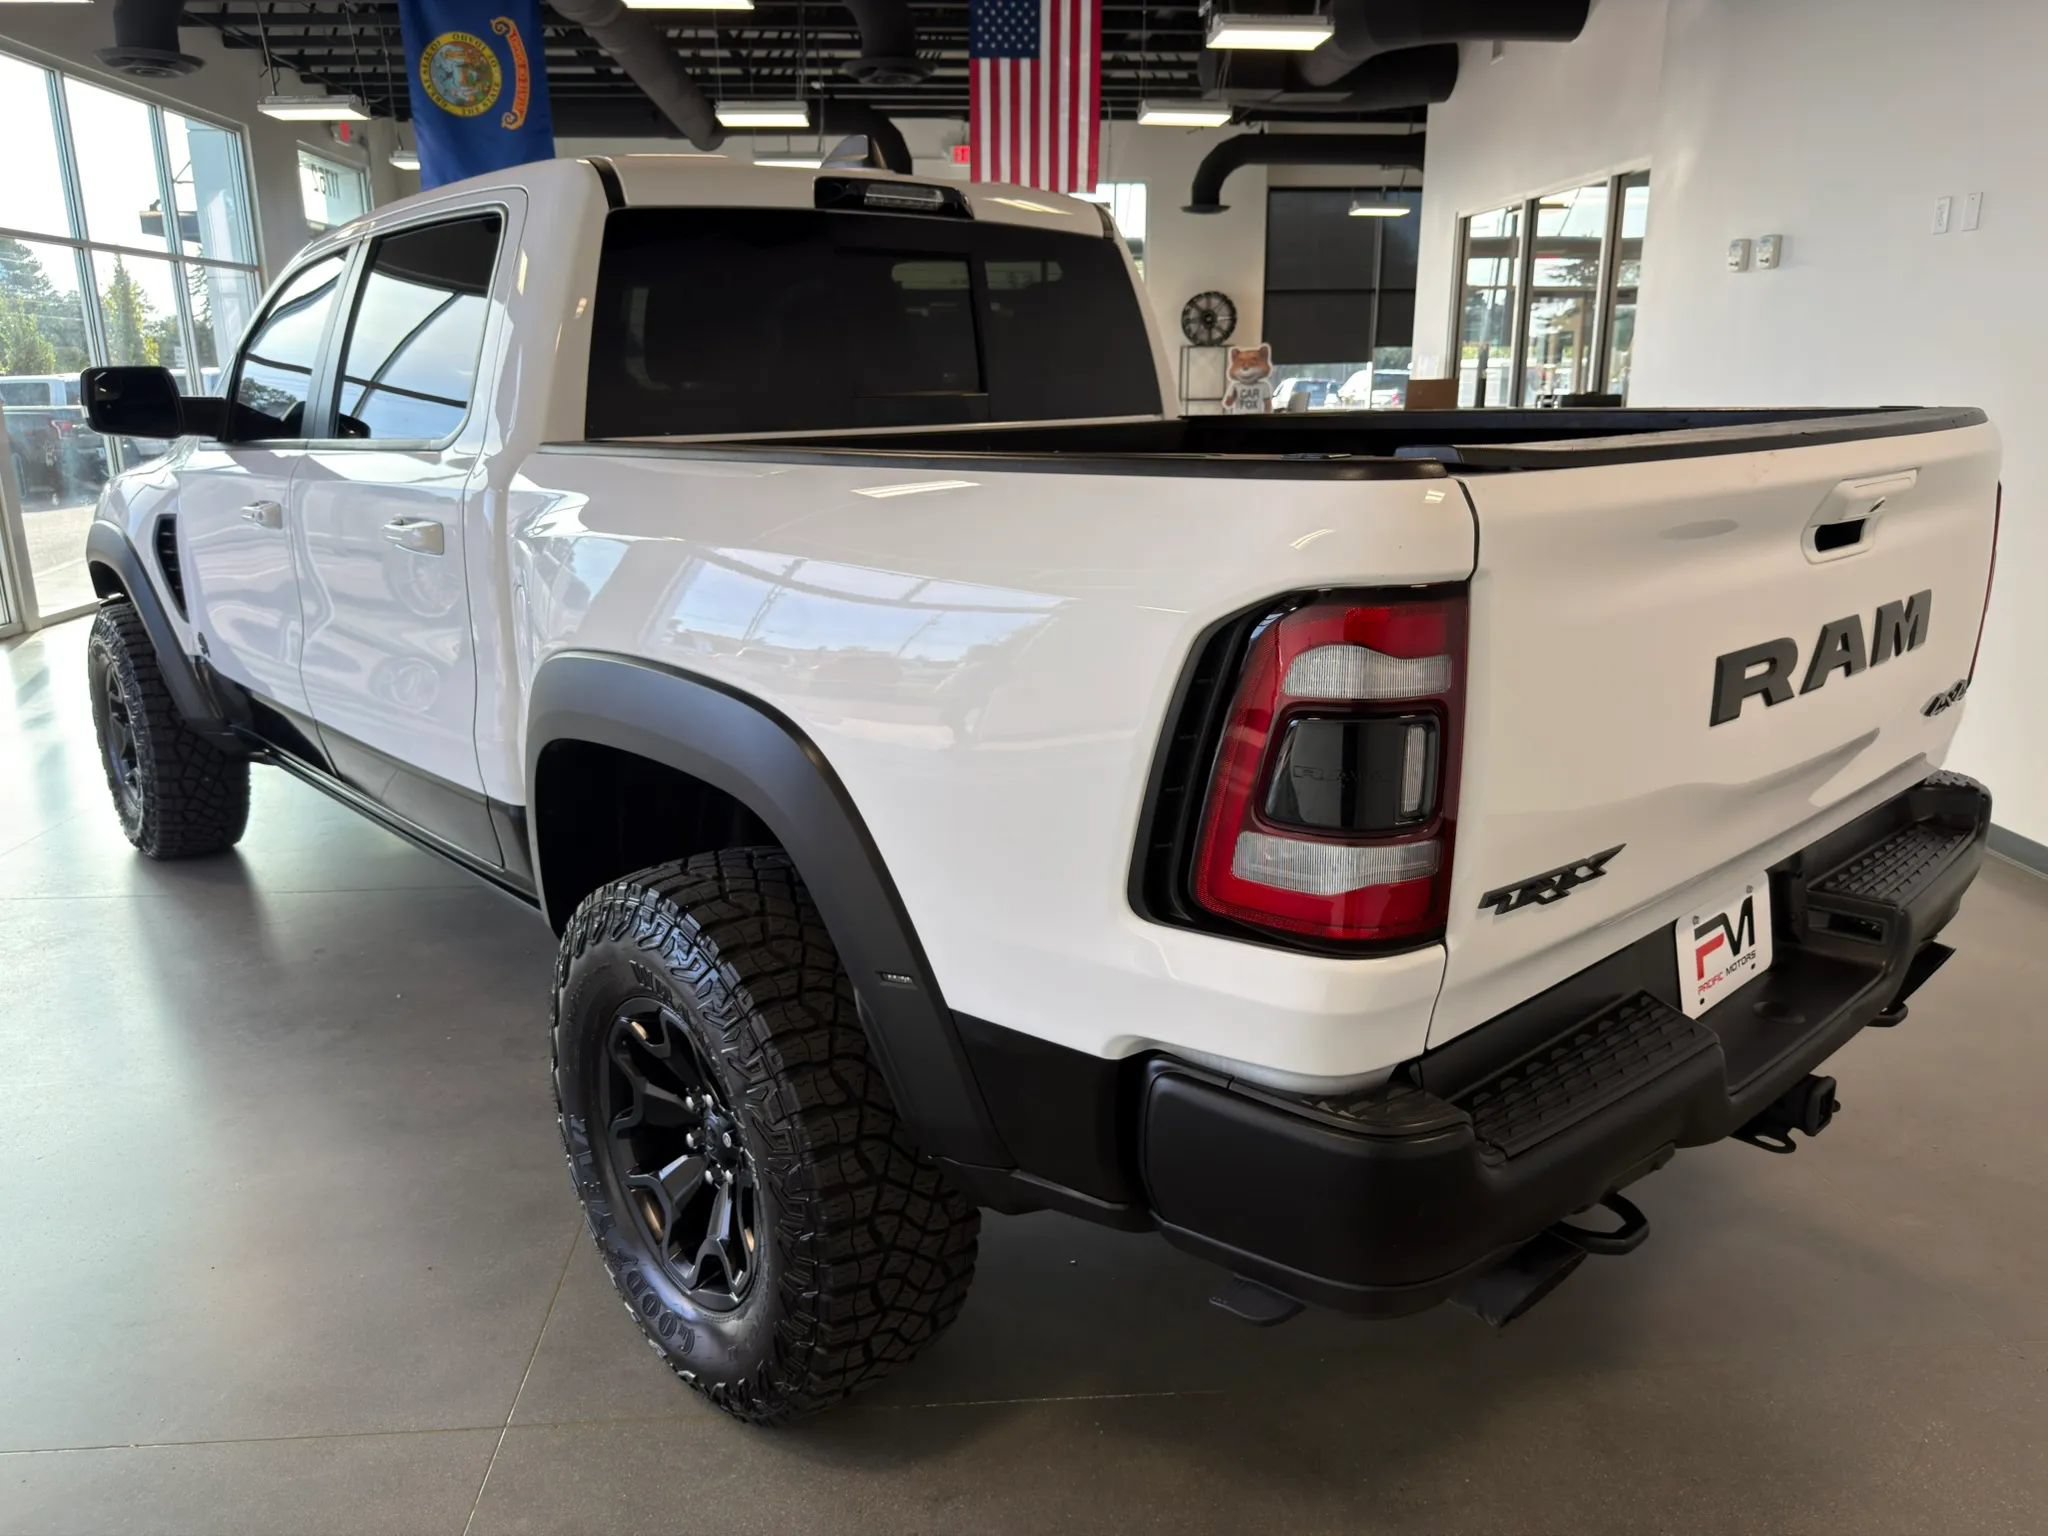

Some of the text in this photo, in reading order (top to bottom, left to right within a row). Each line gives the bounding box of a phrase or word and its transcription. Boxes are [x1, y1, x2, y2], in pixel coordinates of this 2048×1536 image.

[1240, 388, 1260, 400] CAR
[1709, 588, 1932, 727] RAM
[1478, 843, 1627, 915] TRX
[1697, 949, 1757, 995] PACIFIC MOTORS
